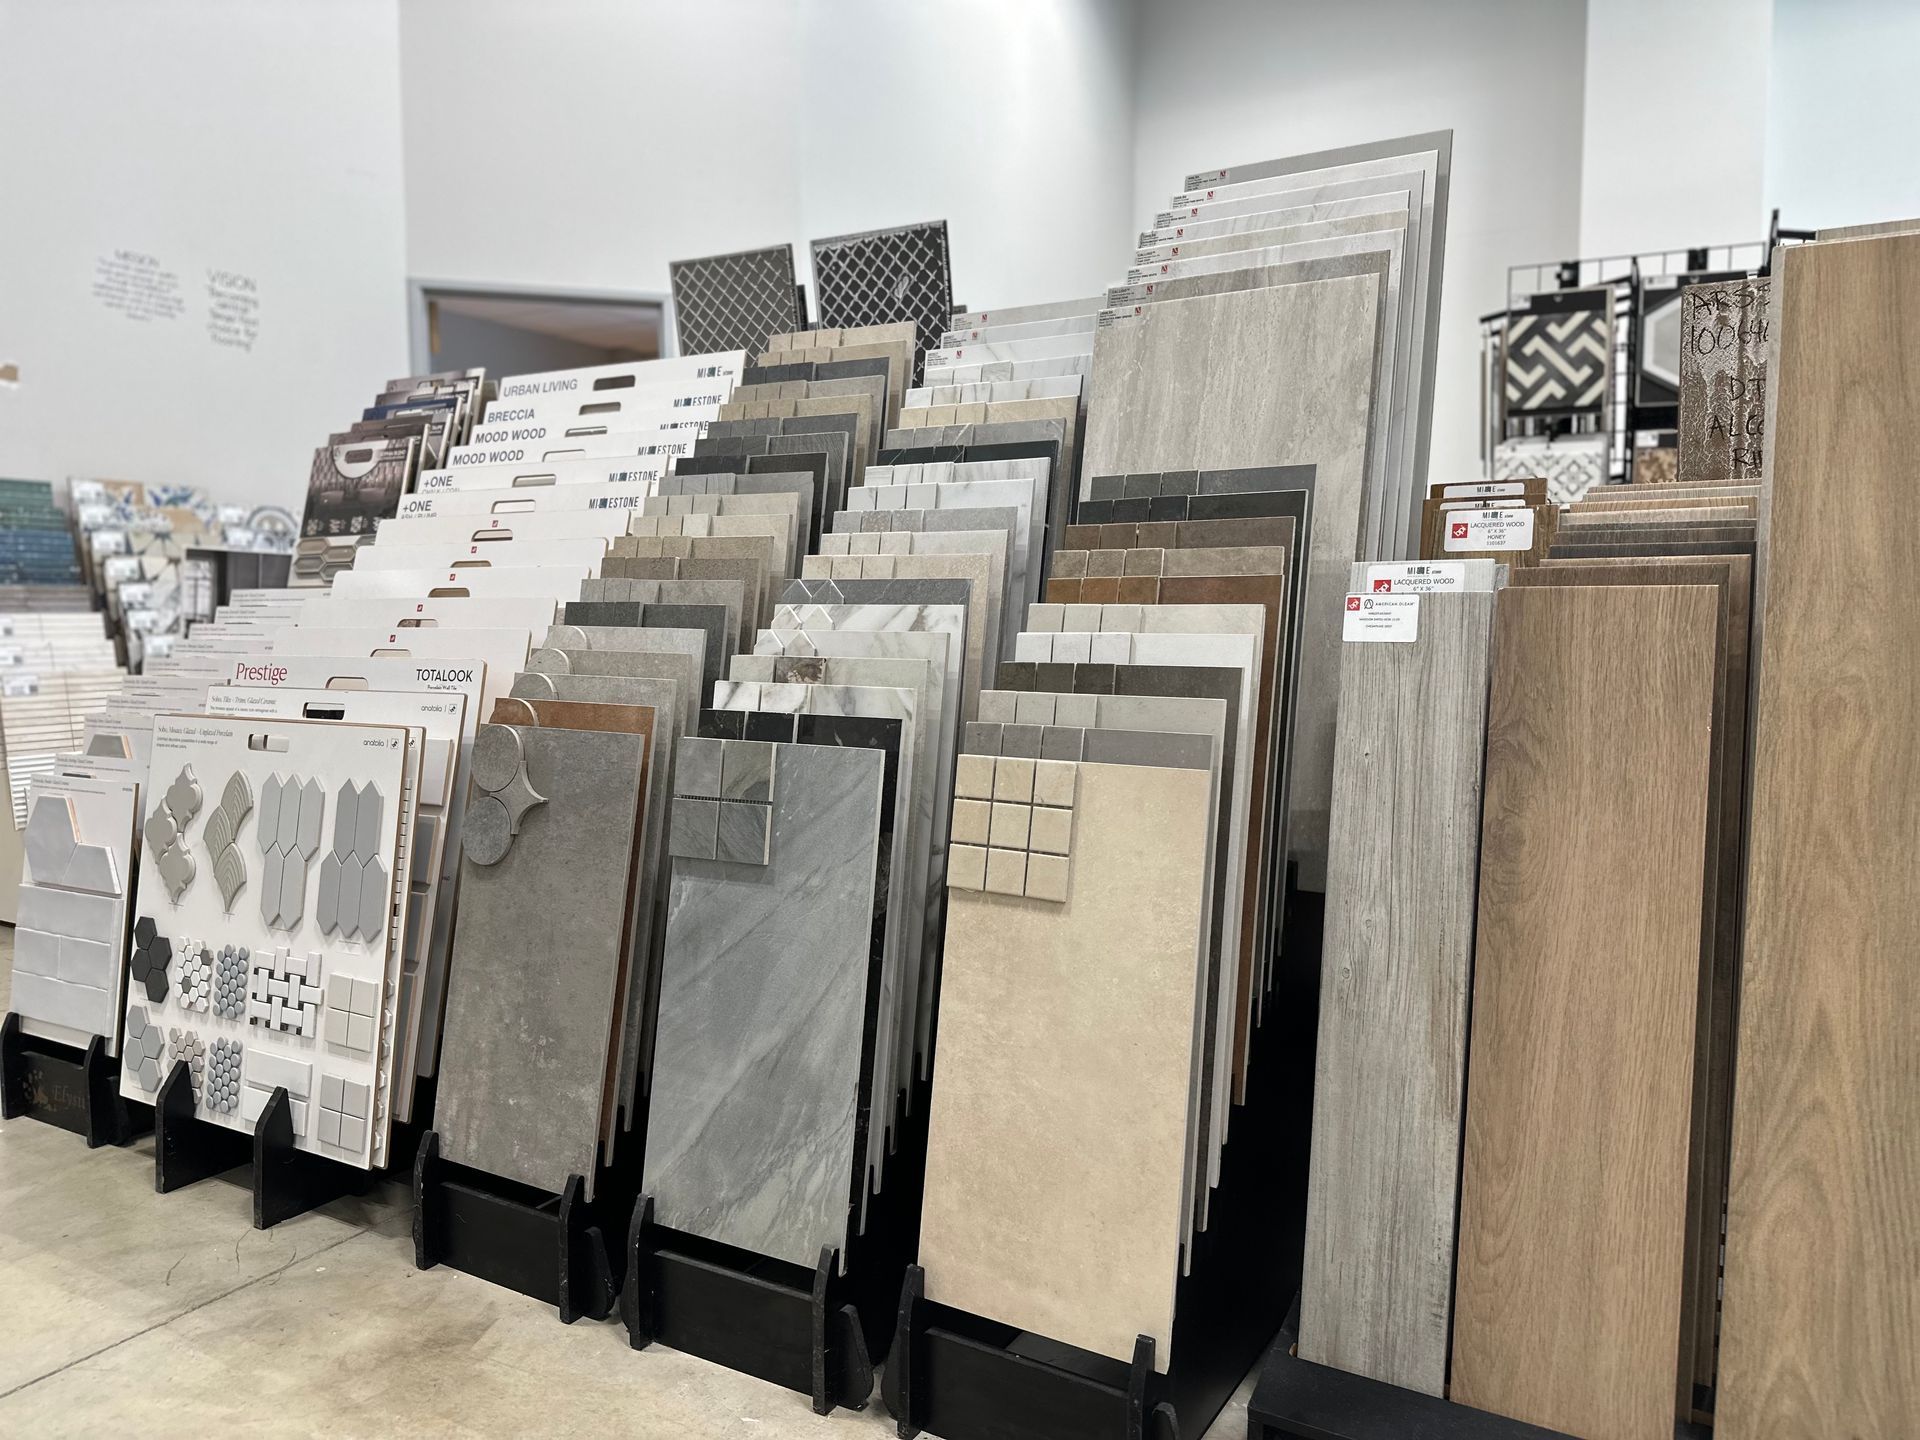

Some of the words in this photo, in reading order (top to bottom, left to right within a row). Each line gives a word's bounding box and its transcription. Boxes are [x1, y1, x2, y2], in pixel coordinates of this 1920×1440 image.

[206, 267, 257, 293] VISION
[503, 383, 540, 397] URBAN
[542, 378, 578, 394] LIVING
[487, 408, 535, 423] BRECCIA
[474, 430, 508, 444] MOOD
[511, 427, 546, 441] WOOD
[452, 452, 486, 466] MOOD
[489, 449, 524, 463] WOOD
[423, 475, 453, 488] +ONE
[403, 500, 433, 512] +ONE
[1470, 521, 1505, 529] LACQUERED
[1393, 578, 1432, 586] LACQUERED
[1433, 577, 1455, 585] WOOD
[235, 662, 288, 686] Prestige
[416, 668, 473, 682] TOTALOOK
[421, 704, 443, 712] anatolia
[363, 739, 385, 747] anatolia
